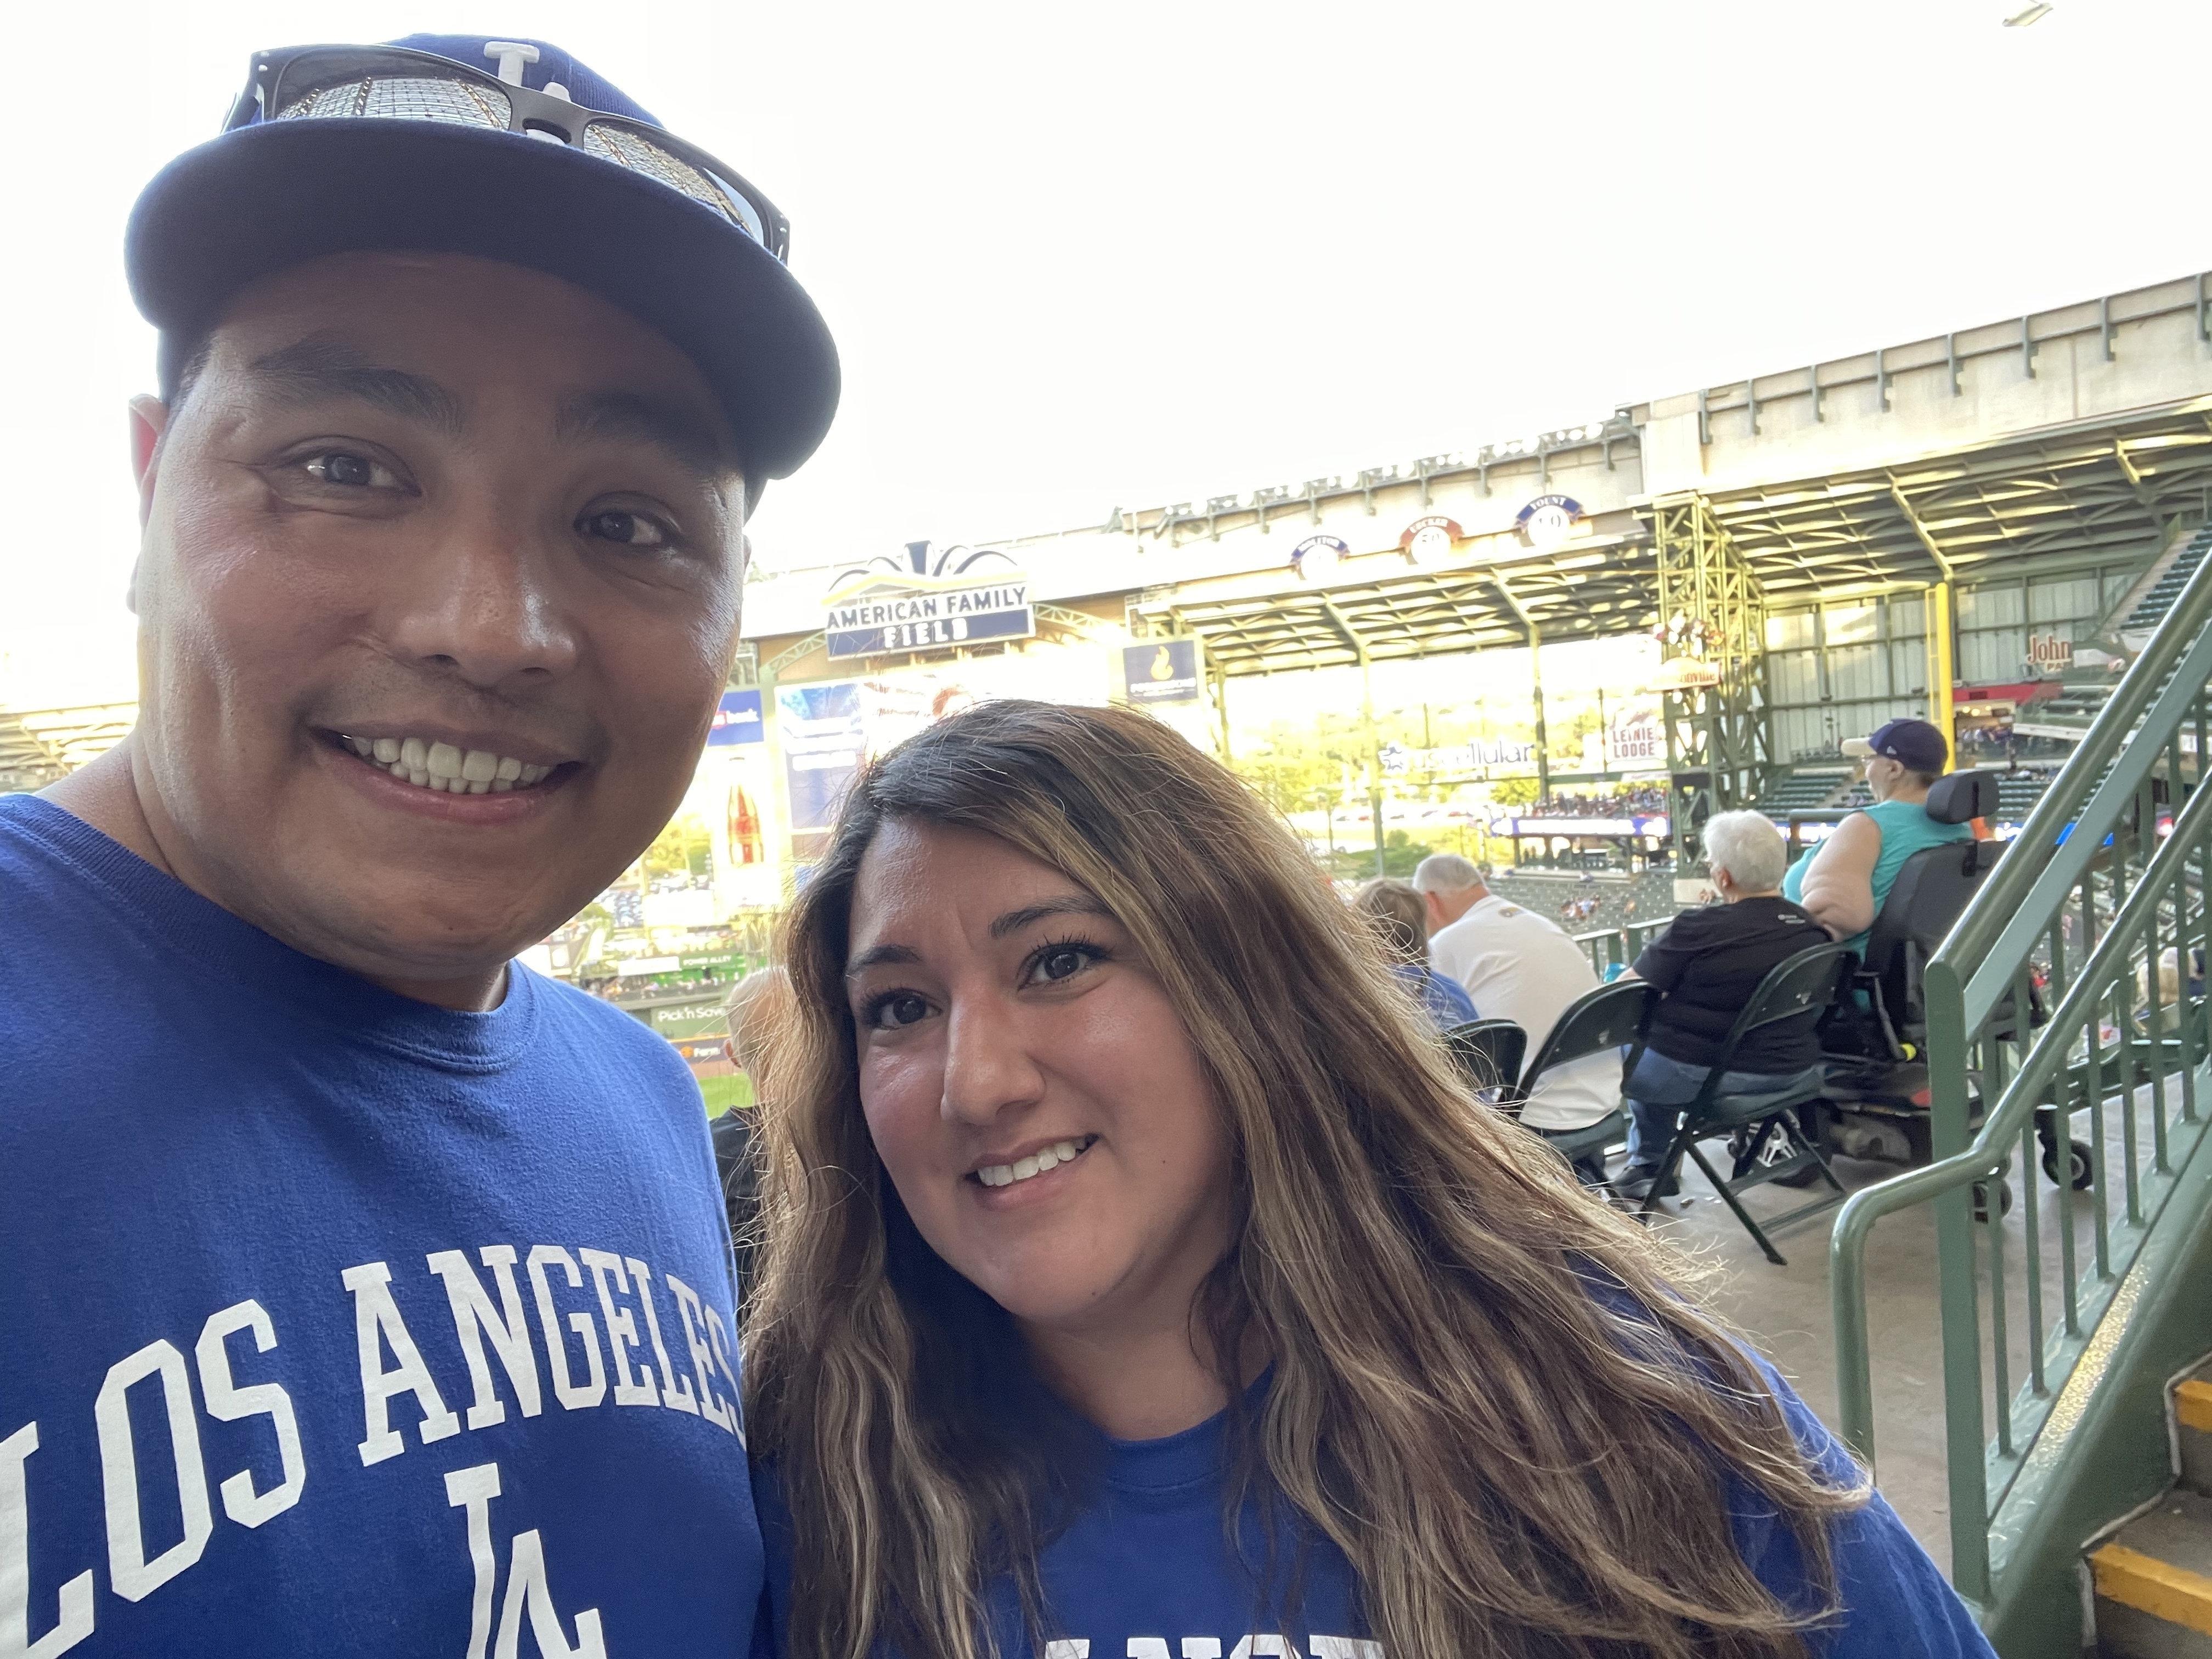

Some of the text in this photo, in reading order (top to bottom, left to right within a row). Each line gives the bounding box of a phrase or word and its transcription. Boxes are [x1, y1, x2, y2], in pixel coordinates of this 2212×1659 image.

[827, 586, 1026, 629] AMERICAN FAMILY
[883, 618, 968, 648] FIELD
[1612, 727, 1655, 743] LEINIE
[1613, 742, 1656, 759] LODGE
[658, 1010, 685, 1022] Pick
[0, 1299, 307, 1659] LOS
